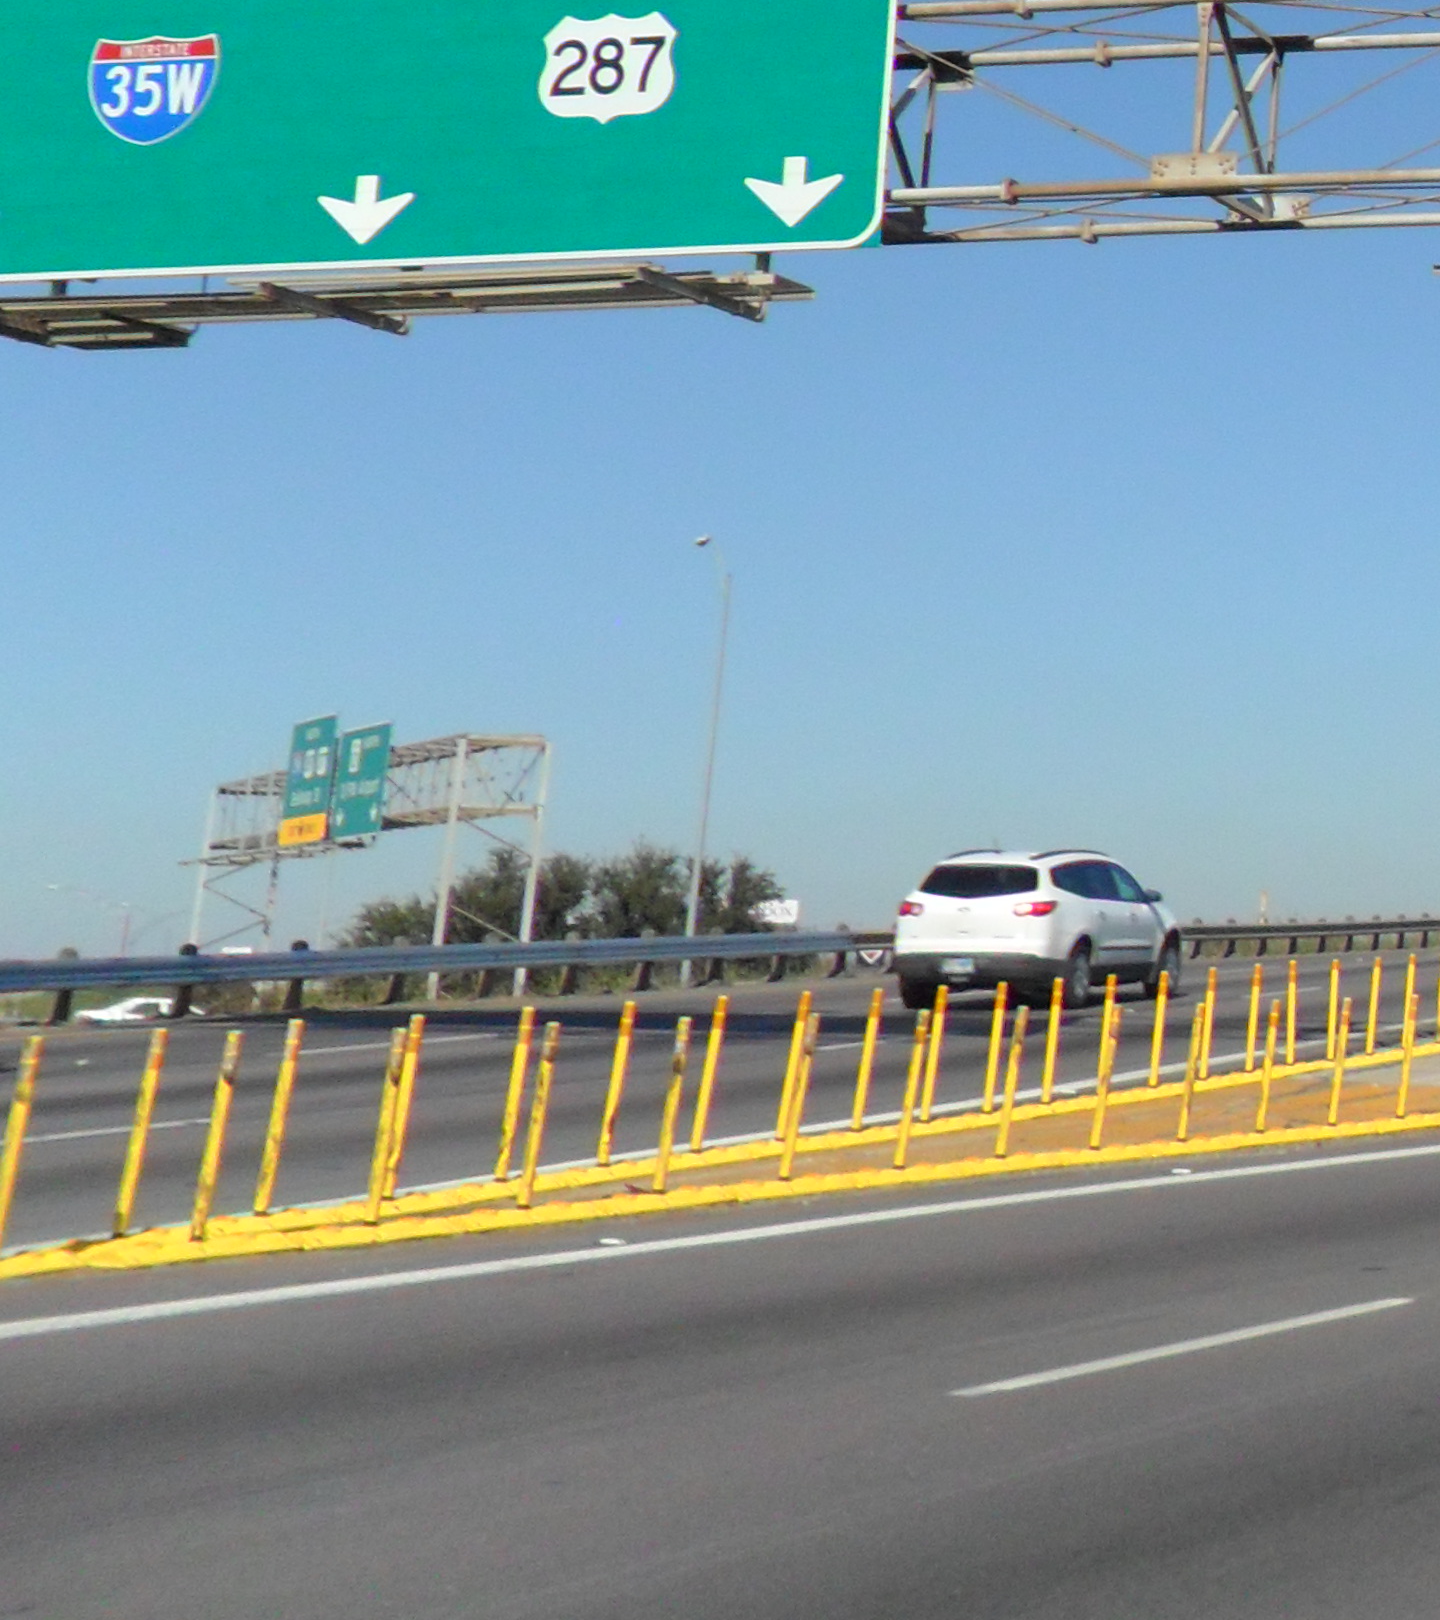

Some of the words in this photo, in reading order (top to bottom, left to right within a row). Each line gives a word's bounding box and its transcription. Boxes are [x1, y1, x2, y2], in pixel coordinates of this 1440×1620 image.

[121, 43, 190, 57] INTERSTATE
[550, 36, 666, 96] 287
[101, 63, 204, 118] 35W
